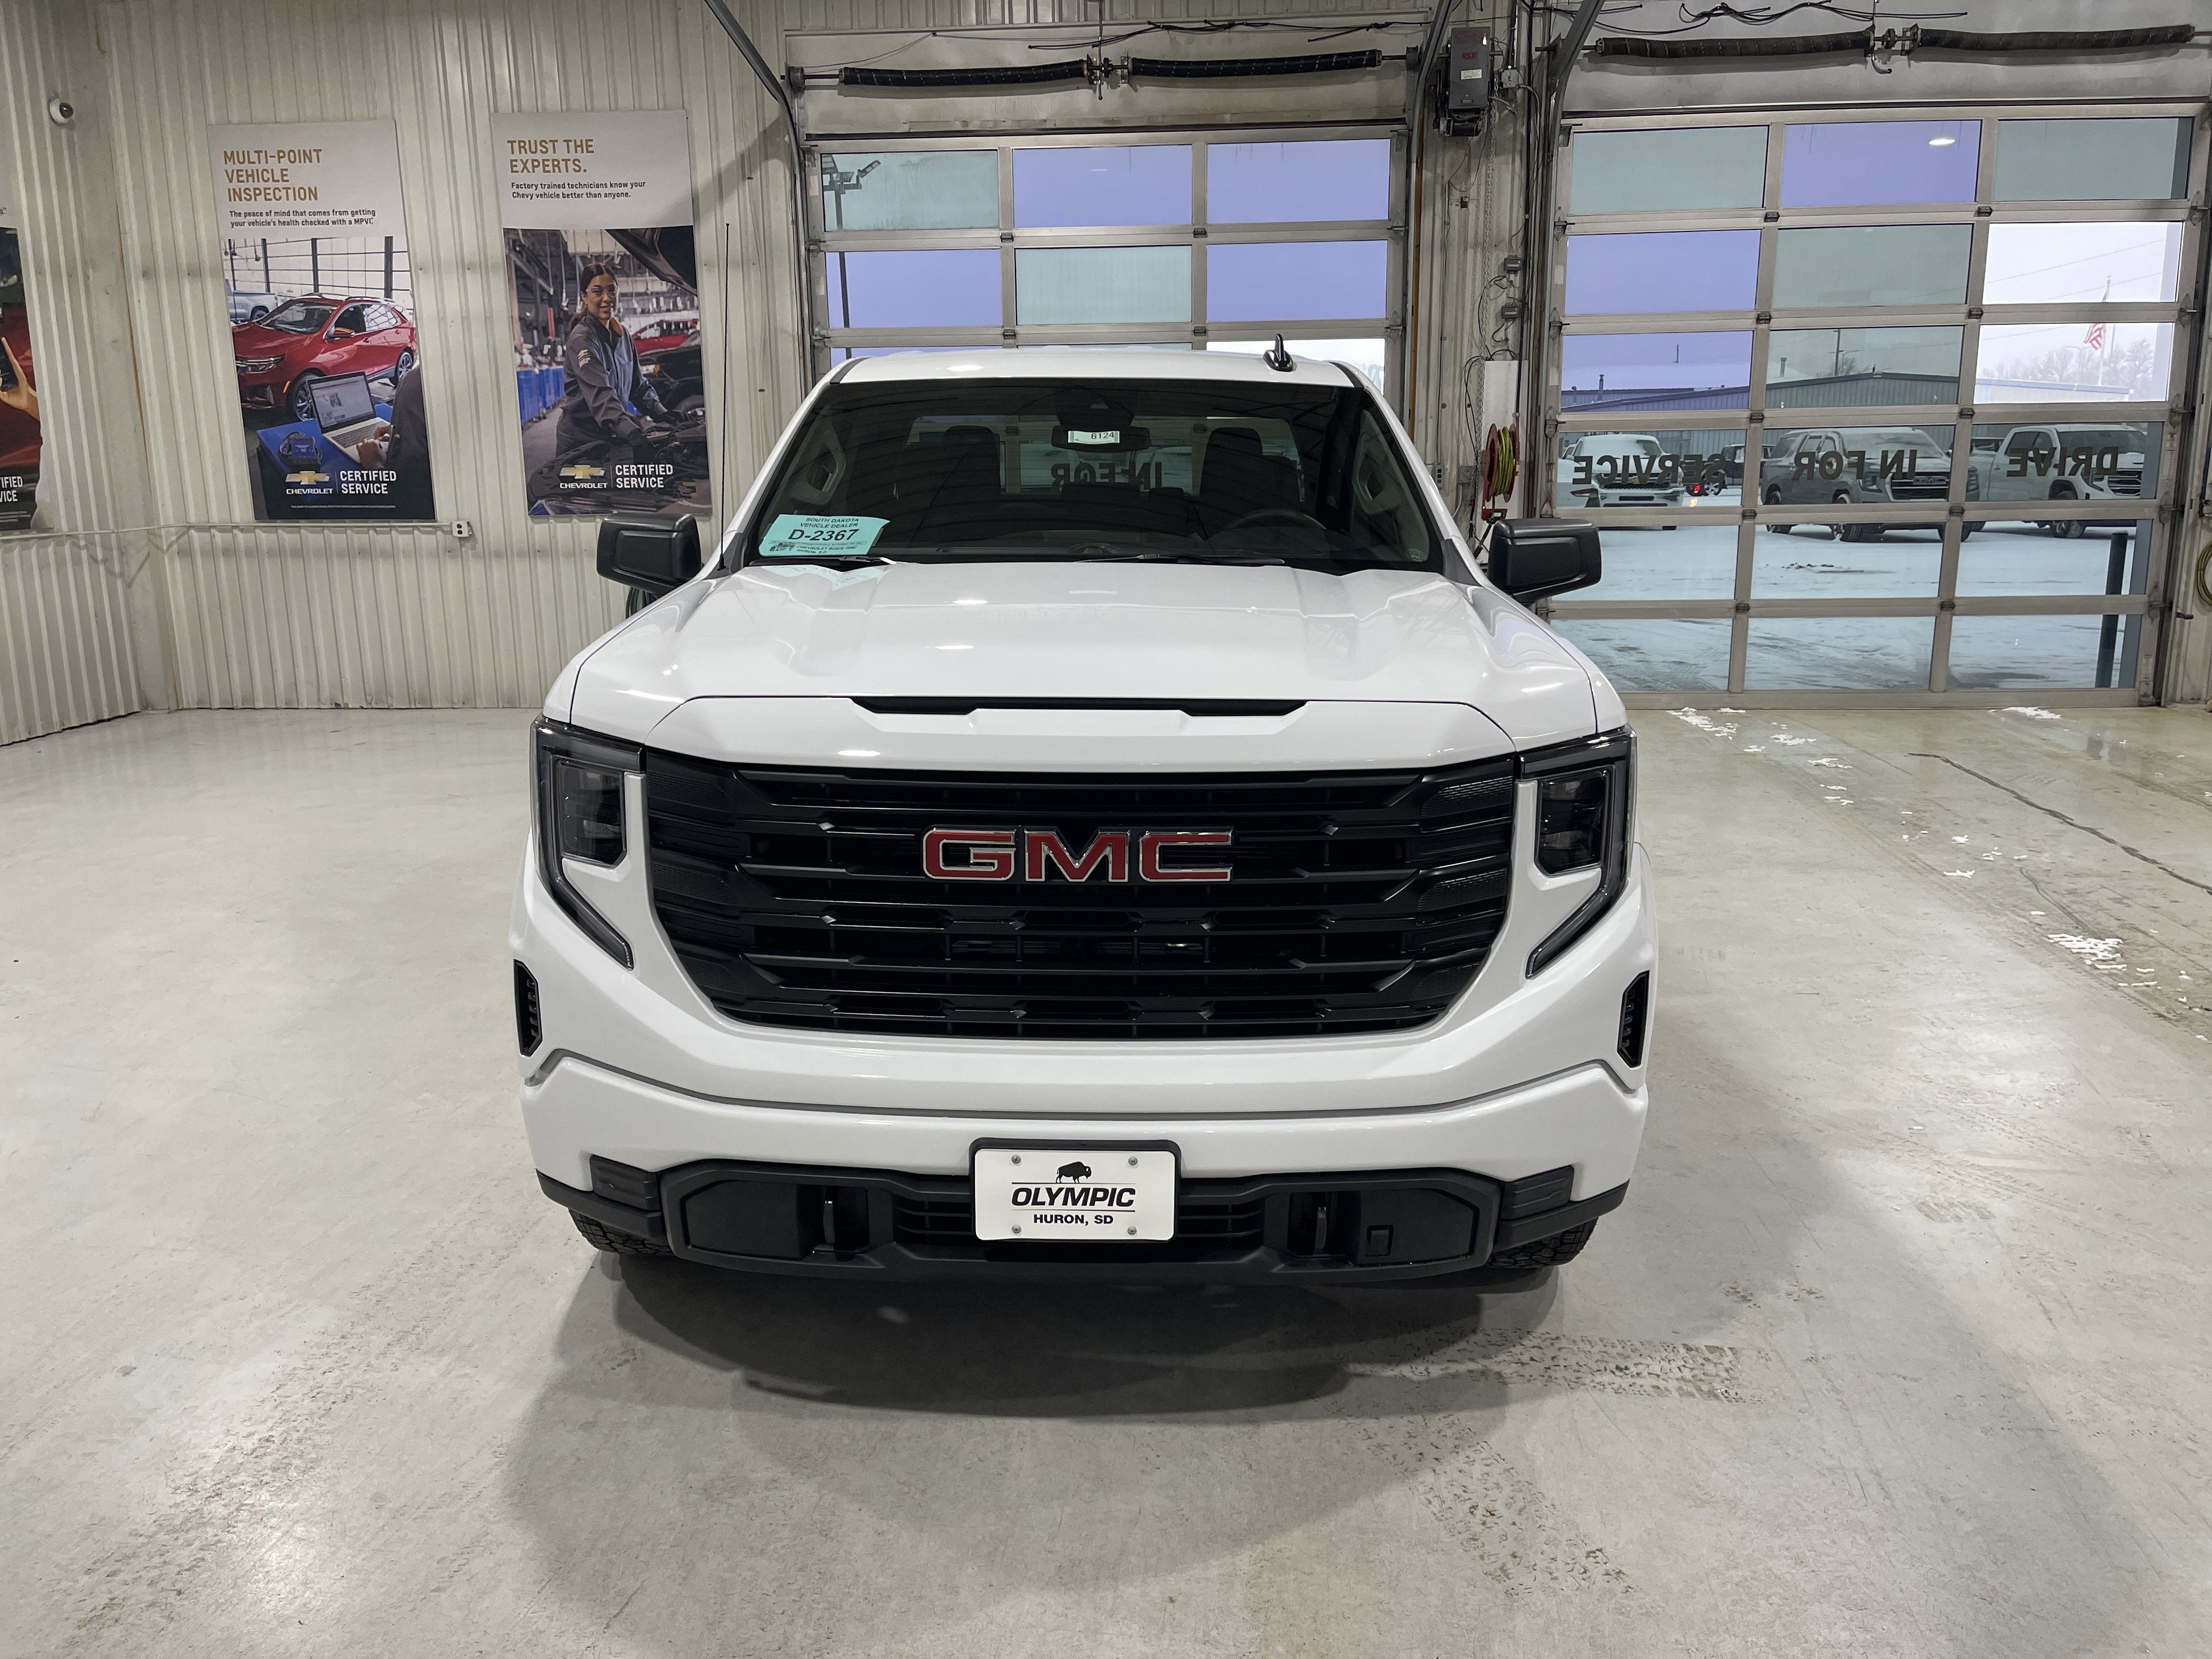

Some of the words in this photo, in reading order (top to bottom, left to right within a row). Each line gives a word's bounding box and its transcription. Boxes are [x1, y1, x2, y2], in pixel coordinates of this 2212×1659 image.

[507, 139, 558, 154] TRUST
[563, 138, 595, 154] THE
[223, 149, 322, 165] MULTI-POINT
[510, 158, 587, 173] EXPERTS.
[225, 168, 289, 183] VEHICLE
[511, 182, 539, 190] Factory
[228, 187, 318, 202] INSPECTION
[351, 208, 376, 217] getting
[340, 470, 397, 481] CERTIFIED
[615, 464, 673, 476] CERTIFIED
[0, 476, 23, 488] IFIED
[616, 477, 664, 489] SERVICE
[341, 483, 388, 494] SERVICE
[788, 528, 860, 541] D-2367
[923, 827, 1233, 882] GMC
[1011, 1187, 1136, 1207] OLYMPIC
[1034, 1214, 1088, 1226] HURON,
[1094, 1214, 1114, 1224] SD
